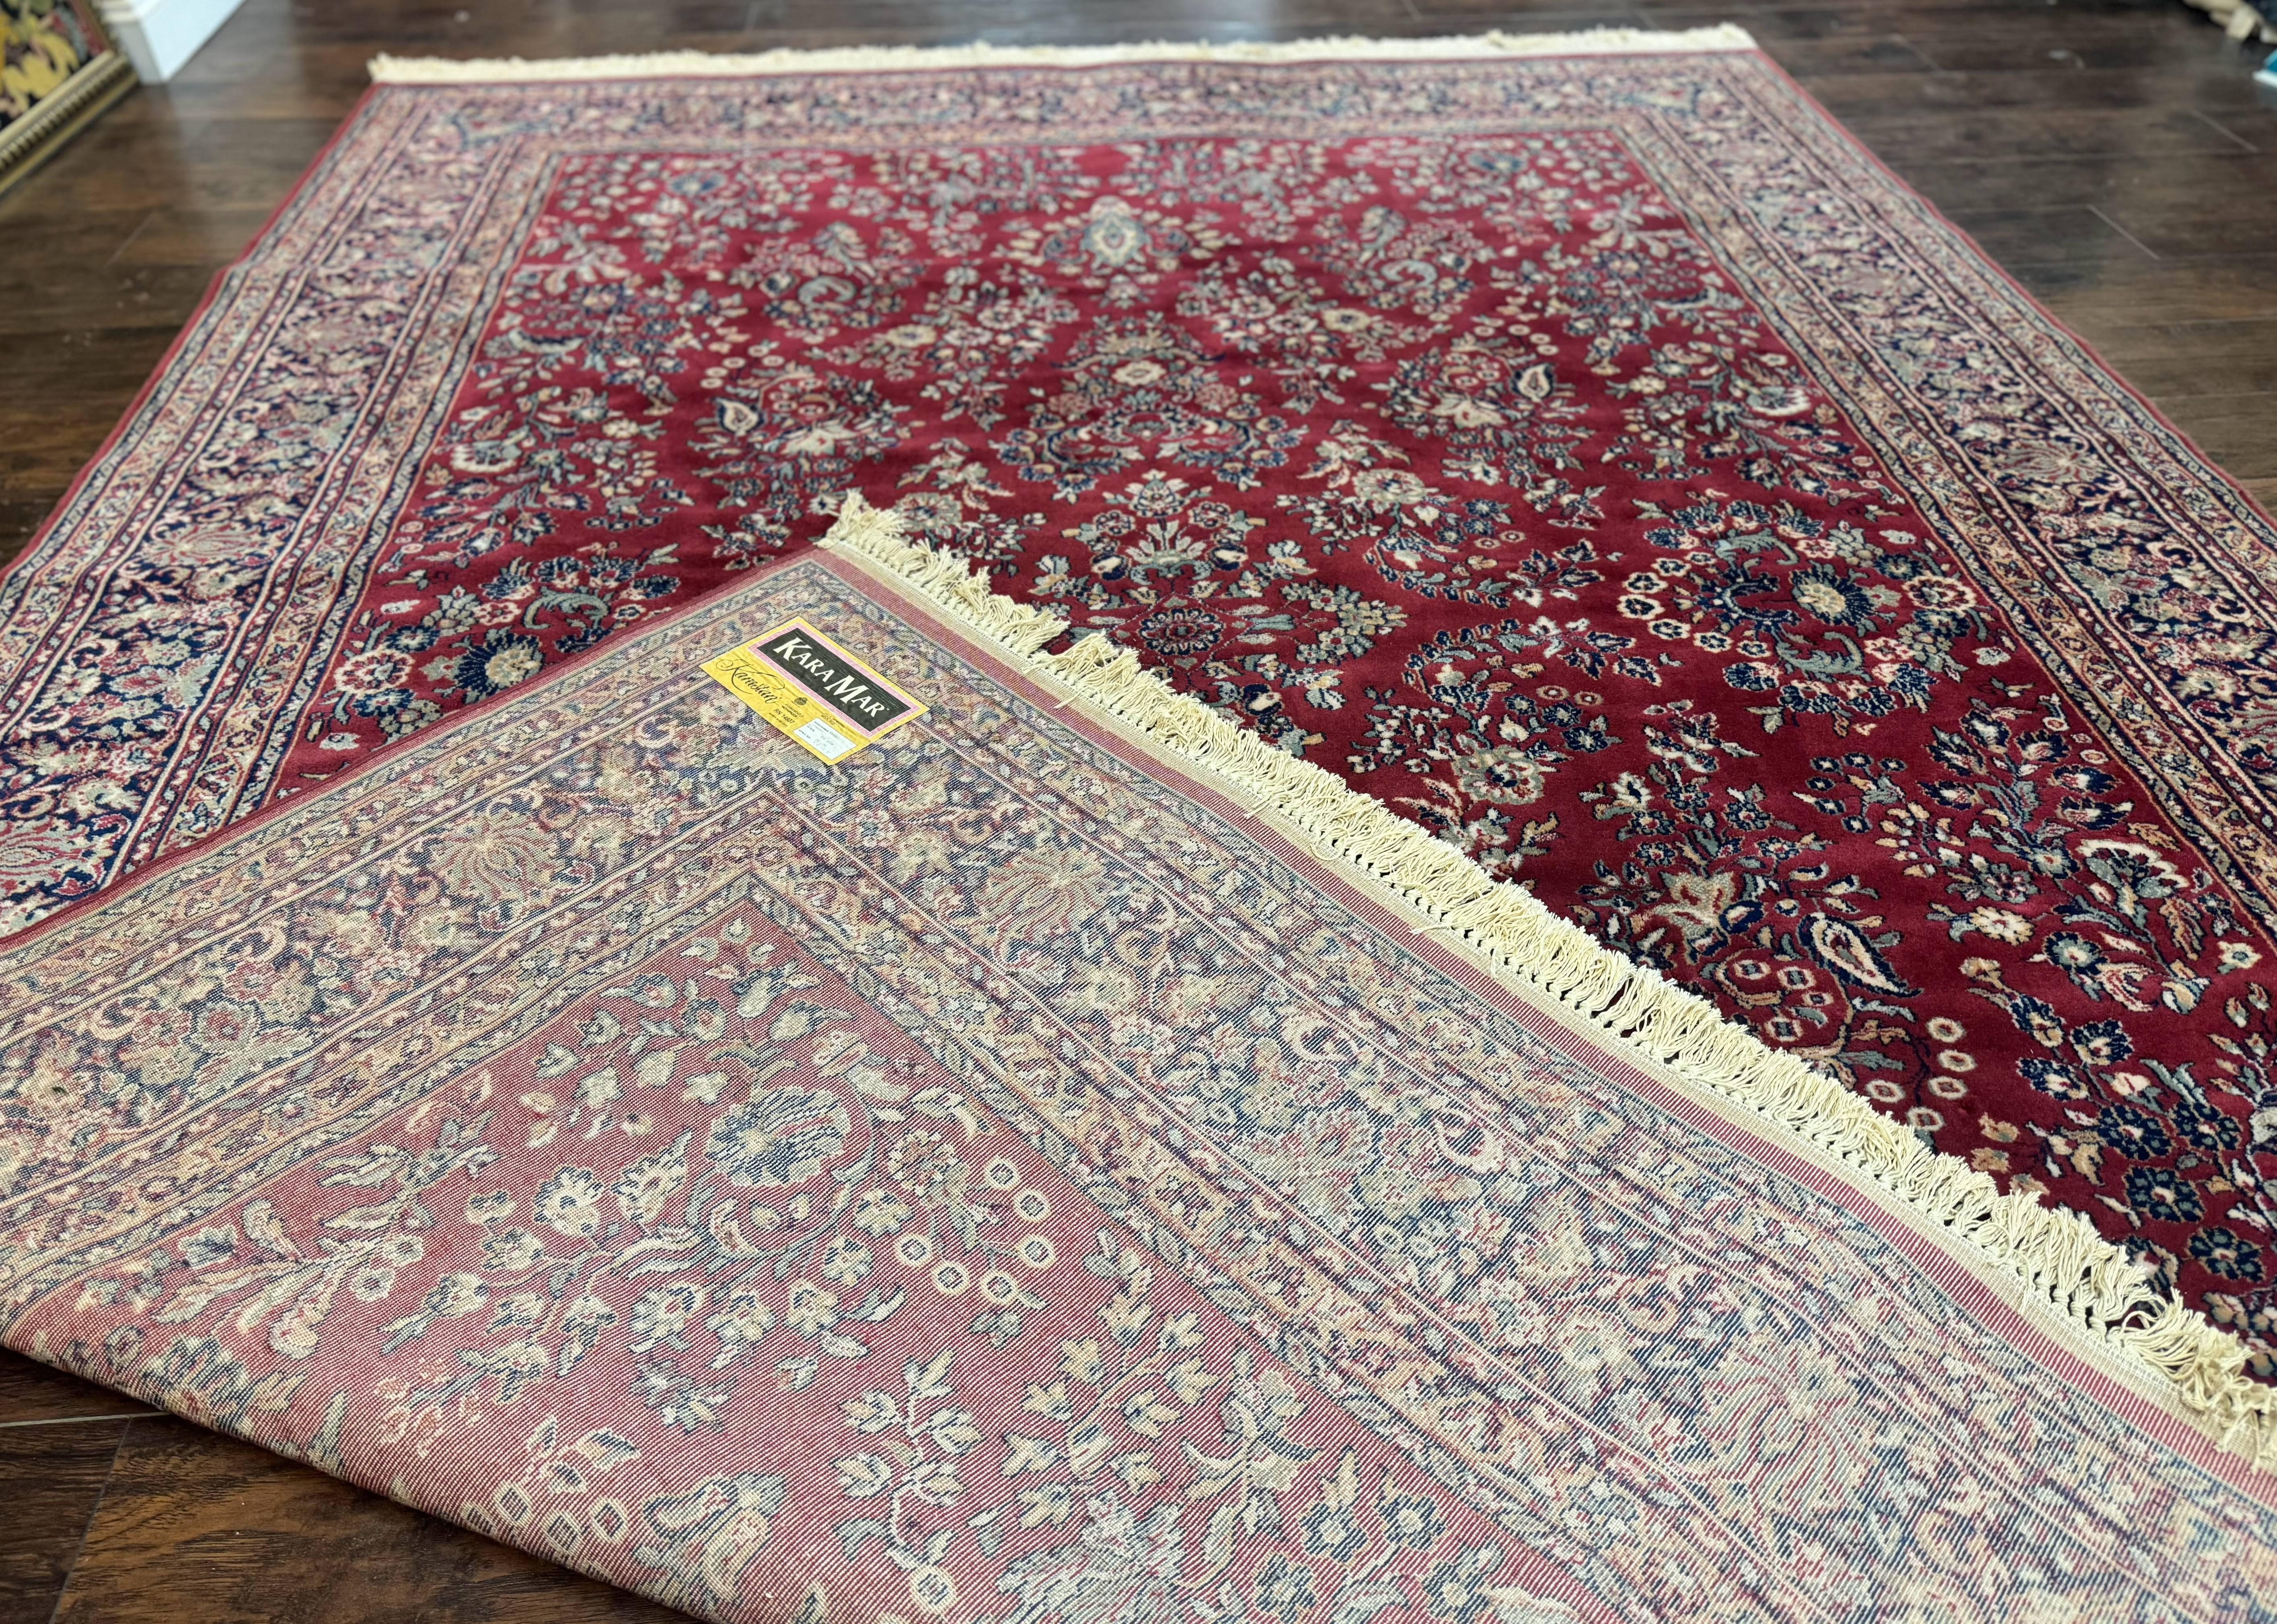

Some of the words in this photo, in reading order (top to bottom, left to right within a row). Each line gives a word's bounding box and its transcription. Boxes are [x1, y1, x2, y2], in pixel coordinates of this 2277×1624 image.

[716, 659, 785, 703] Karastan
[773, 637, 834, 682] KARA
[824, 674, 885, 717] MAR
